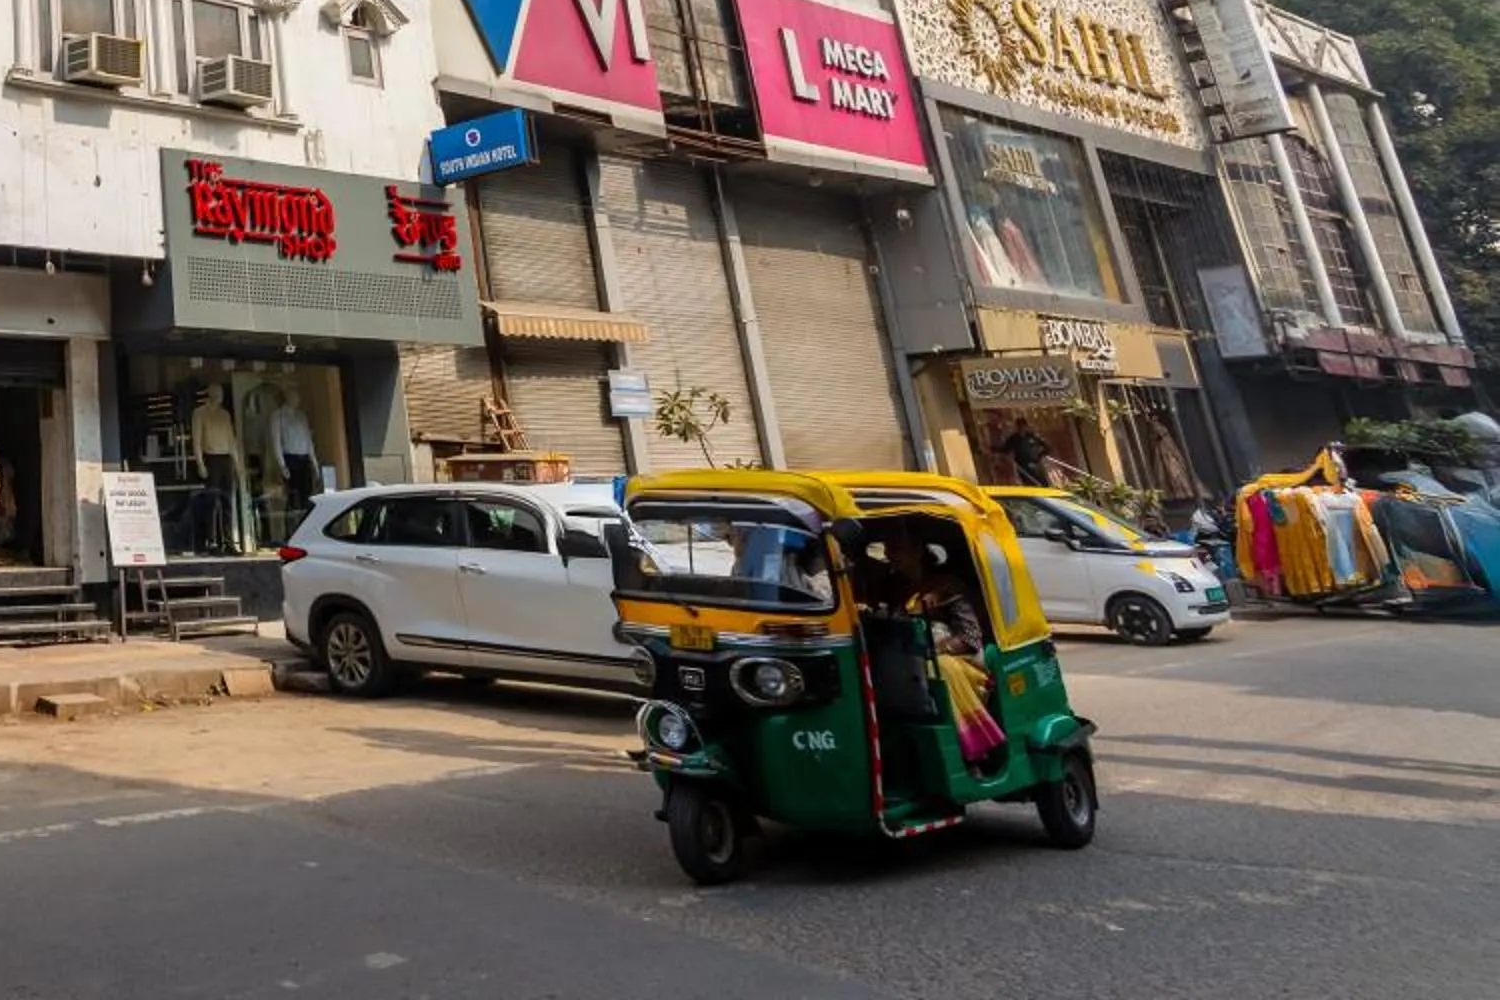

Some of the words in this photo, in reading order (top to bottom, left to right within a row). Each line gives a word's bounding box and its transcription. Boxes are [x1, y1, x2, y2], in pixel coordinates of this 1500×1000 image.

[821, 36, 890, 82] MEGA
[828, 78, 898, 121] MART
[975, 366, 1063, 386] BOMBAY
[792, 730, 836, 750] CNG
